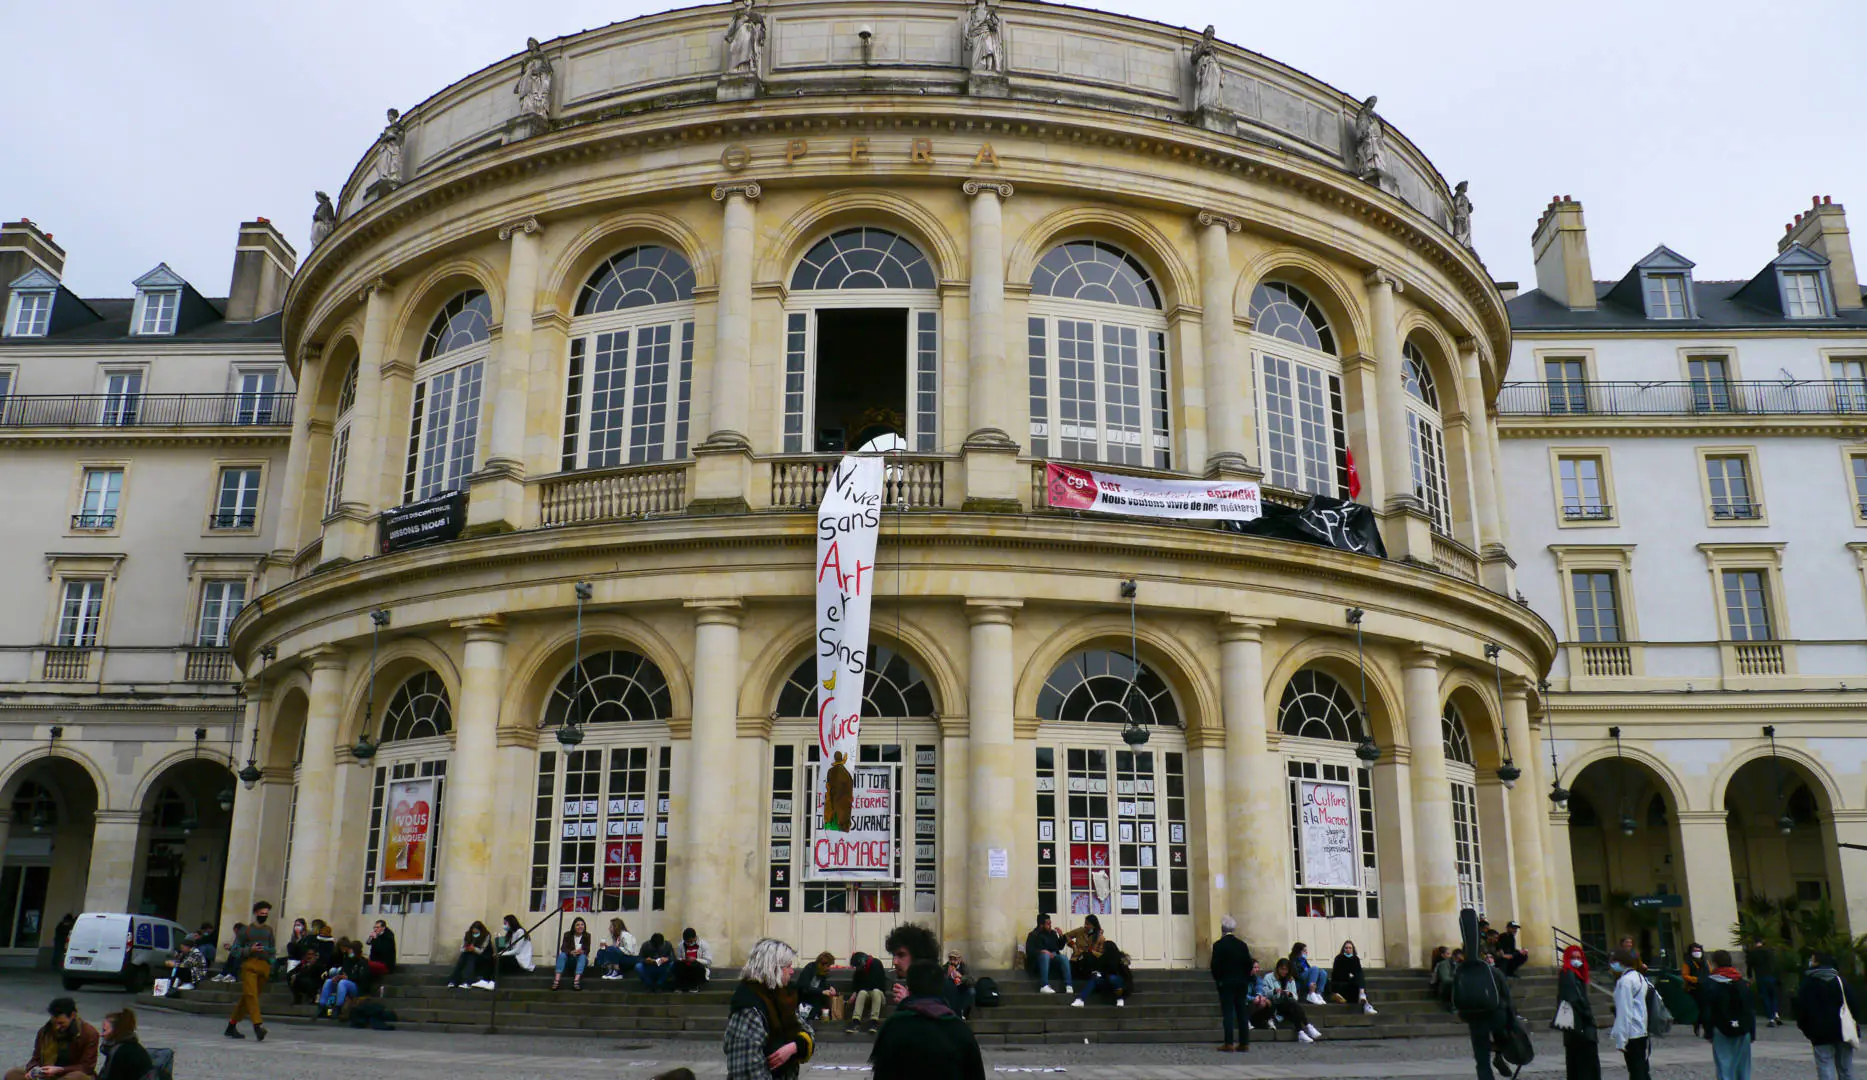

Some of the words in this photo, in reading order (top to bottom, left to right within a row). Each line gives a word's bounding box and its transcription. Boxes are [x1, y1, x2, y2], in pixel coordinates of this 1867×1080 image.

[721, 137, 1001, 171] OPERA
[836, 464, 879, 506] Vivre
[1100, 481, 1121, 493] CGT
[1101, 493, 1126, 505] Nous
[1128, 496, 1165, 508] voulons
[1166, 498, 1189, 510] vivre
[1190, 500, 1202, 511] de
[1203, 501, 1219, 512] nos
[818, 540, 873, 596] Art
[827, 592, 851, 623] et
[1303, 787, 1314, 806] La
[1313, 783, 1346, 808] Culture
[851, 815, 890, 831] SURANCE
[1303, 811, 1309, 825] à
[1310, 807, 1319, 825] la
[814, 838, 890, 869] CHÔMAGE
